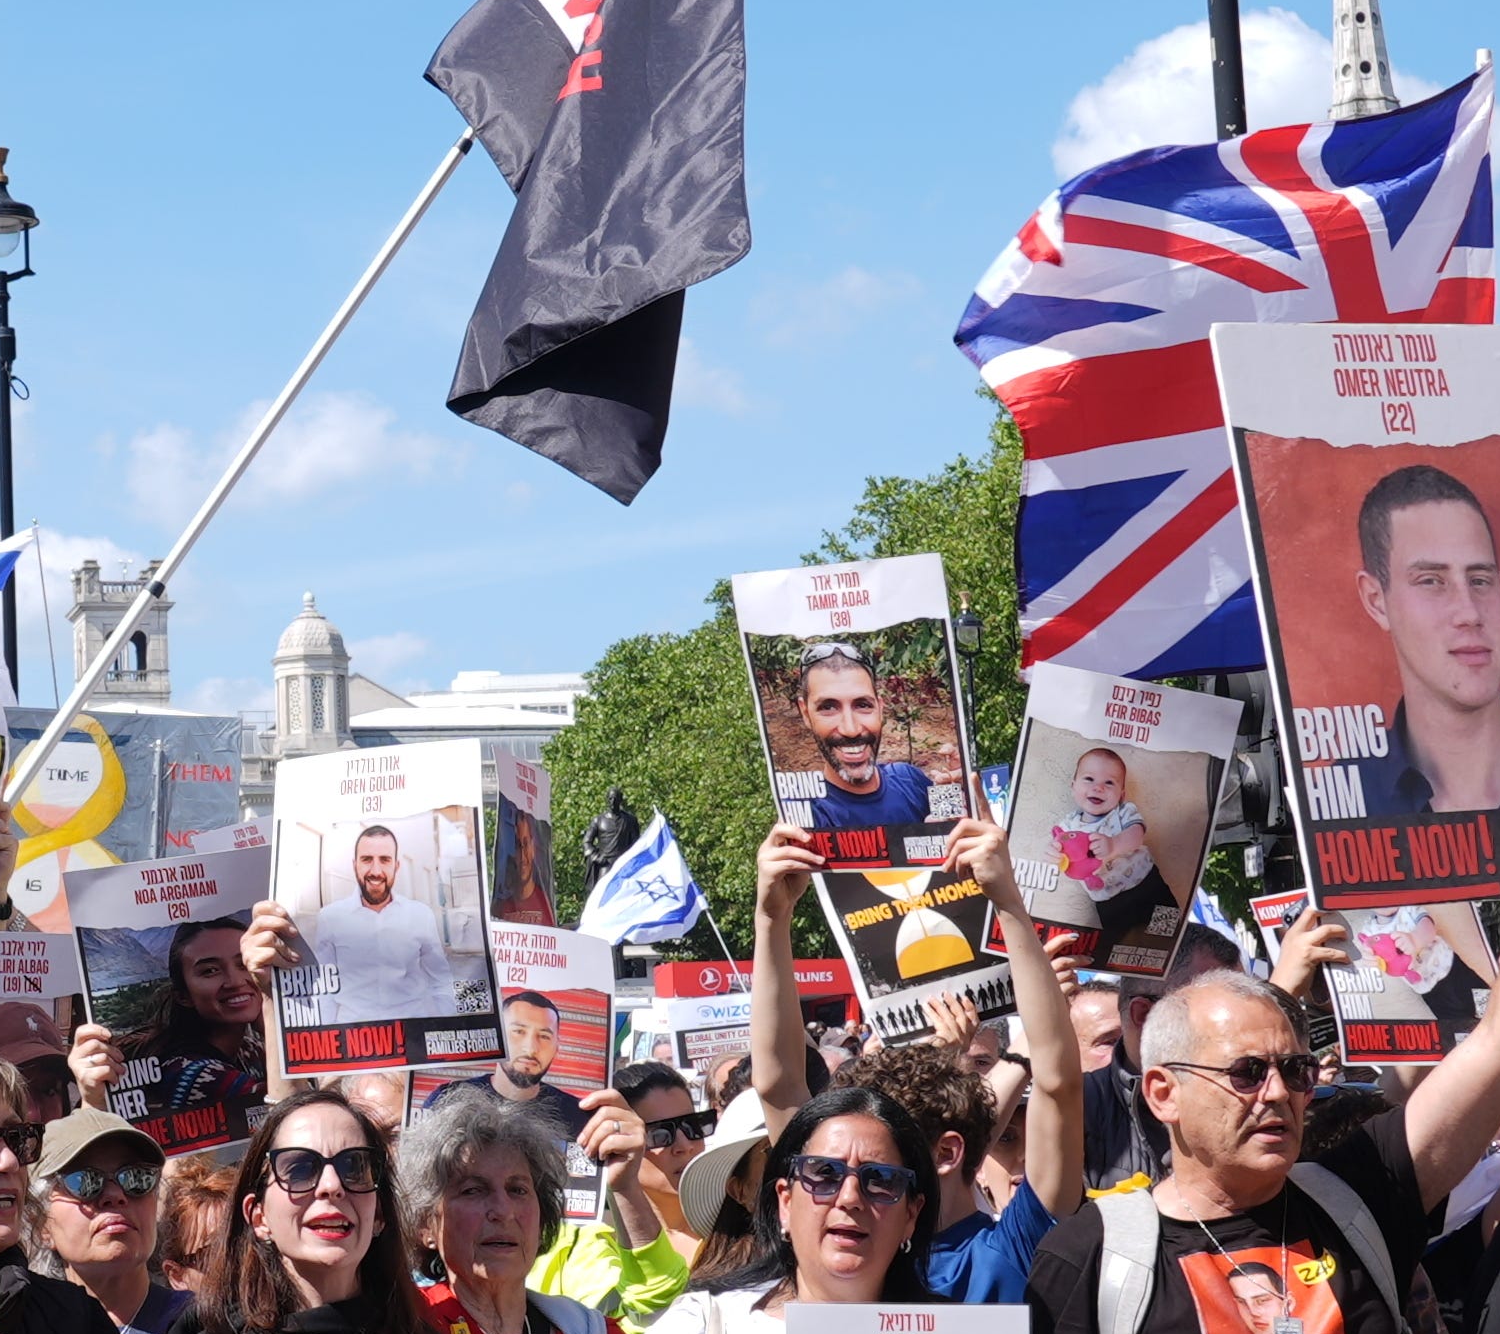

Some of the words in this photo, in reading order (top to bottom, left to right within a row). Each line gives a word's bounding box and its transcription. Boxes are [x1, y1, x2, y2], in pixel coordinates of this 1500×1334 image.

[1332, 334, 1393, 363] נאוטרה
[1392, 335, 1437, 363] עומר
[1333, 368, 1381, 398] OMER
[1385, 368, 1450, 398] NEUTRA
[1380, 401, 1416, 435] (22)
[806, 593, 839, 611] TAMIR
[842, 589, 871, 607] ADAR
[829, 610, 852, 629] (38)
[1104, 702, 1128, 720] KFIR
[1129, 707, 1162, 727] BIBAS
[1294, 703, 1389, 762] BRING
[46, 768, 90, 783] TIME
[169, 762, 233, 783] THEM
[340, 779, 367, 796] OREN
[369, 774, 406, 792] GOLDIN
[361, 795, 383, 814] (33)
[1303, 763, 1367, 821] HIM
[837, 826, 889, 857] NOW!
[1315, 825, 1405, 887] HOME
[1407, 814, 1498, 877] NOW!
[25, 878, 42, 892] IS
[134, 887, 158, 905] NOA
[160, 879, 218, 903] ARGAMANI
[167, 900, 191, 920] (26)
[896, 894, 935, 917] THEM
[17, 958, 50, 976] ALBAG
[513, 950, 568, 969] ALZAYADNI
[3, 976, 22, 994] (19)
[507, 967, 528, 984] (22)
[282, 996, 323, 1028] HIM
[1339, 994, 1374, 1020] HIM
[286, 1030, 343, 1063] HOME
[345, 1020, 406, 1058] NOW!
[425, 1039, 466, 1056] FAMILIES
[1345, 1024, 1393, 1052] HOME
[1394, 1021, 1443, 1051] NOW!
[111, 1092, 149, 1120] HER
[171, 1105, 230, 1138] NOW!
